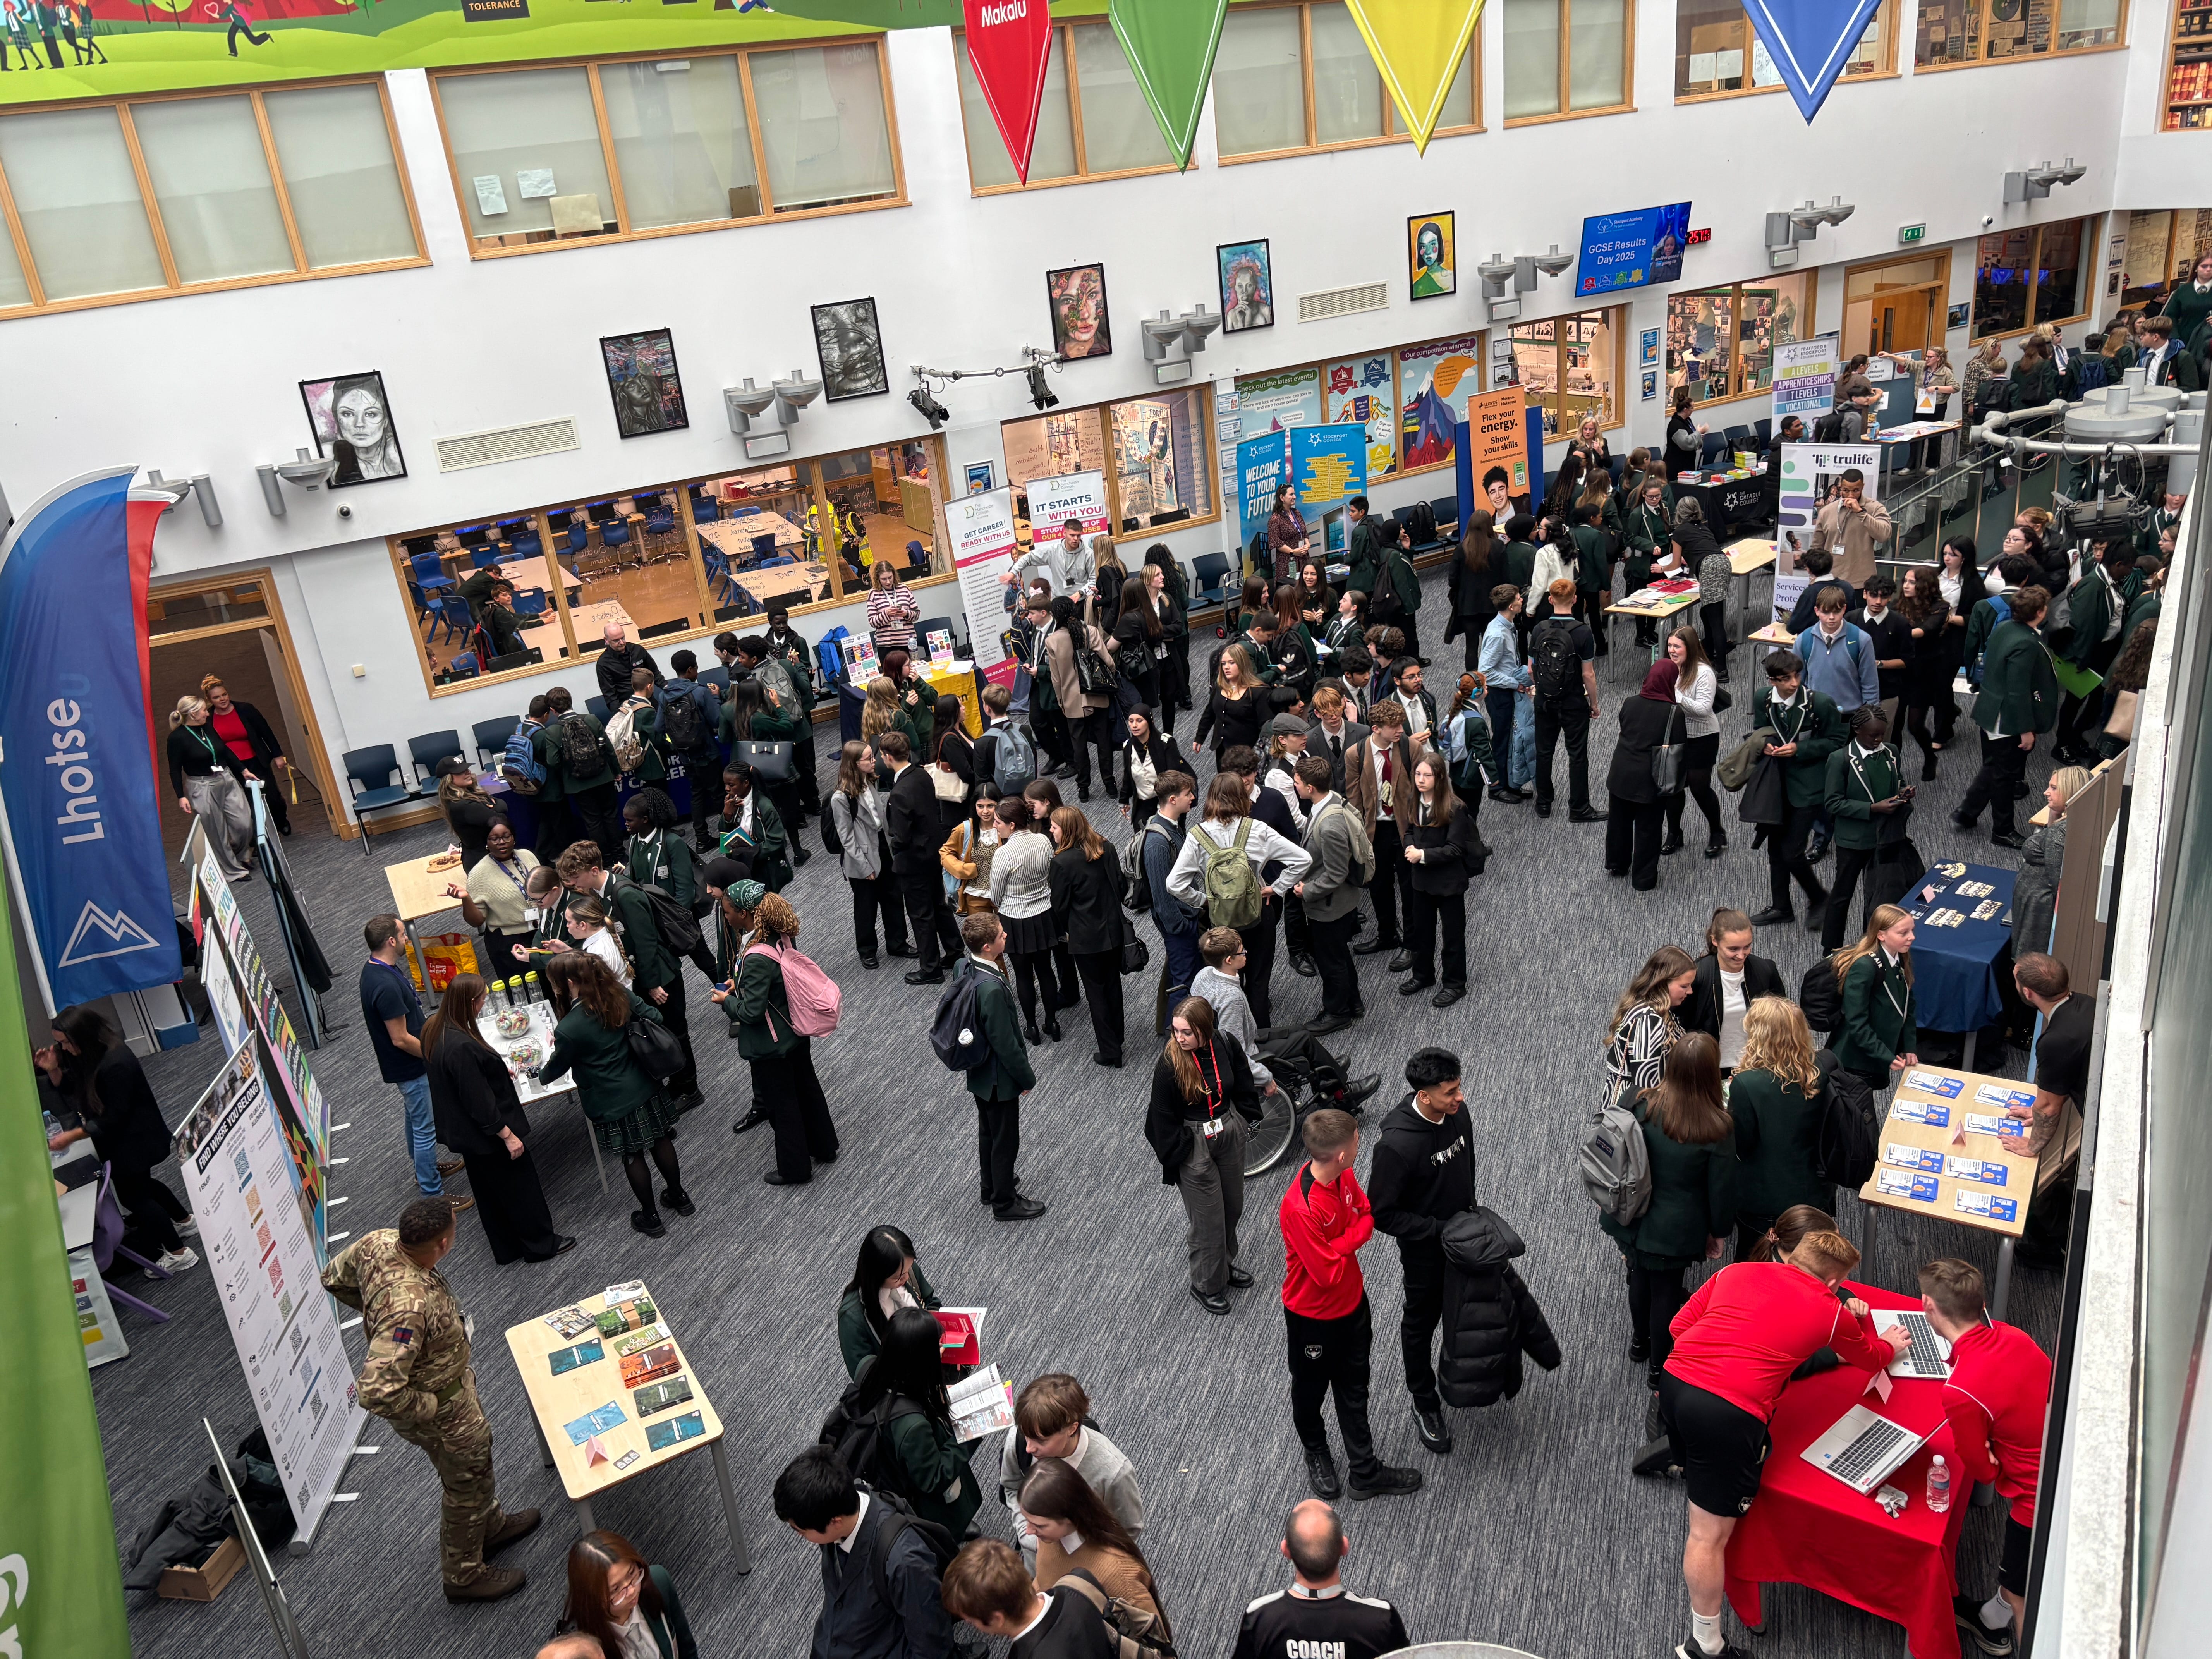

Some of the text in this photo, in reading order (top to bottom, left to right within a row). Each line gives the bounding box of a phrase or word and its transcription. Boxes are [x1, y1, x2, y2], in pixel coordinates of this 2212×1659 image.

[469, 0, 521, 12] TOLERANCE
[981, 0, 1027, 28] Makalu
[1589, 238, 1646, 254] GCSE Results
[1597, 251, 1635, 265] Day 2025
[1417, 346, 1448, 357] competition
[1449, 341, 1470, 350] winners!
[1796, 364, 1819, 375] LEVELS
[1237, 385, 1255, 393] Check
[1294, 372, 1314, 381] events!
[1778, 373, 1832, 390] APPRENTICESHIPS
[1791, 387, 1817, 400] T LEVELS
[1786, 399, 1822, 412] VOCATIONAL
[1482, 409, 1515, 422] Flex your
[1481, 419, 1518, 433] energy.
[1491, 434, 1510, 445] Show
[1484, 441, 1518, 456] your skills
[1833, 453, 1873, 465] trulife
[1246, 459, 1281, 483] WELCOME
[1247, 478, 1276, 499] TO YOUR
[1740, 491, 1761, 501] CHEADLE
[1036, 494, 1092, 512] IT STARTS
[1740, 497, 1759, 506] COLLEGE
[1048, 506, 1101, 521] WITH YOU
[964, 520, 1003, 539] GET CAREER
[1041, 527, 1063, 535] STUDY
[961, 537, 982, 549] READY
[984, 532, 1001, 543] WITH
[1777, 582, 1806, 591] Services
[1776, 593, 1797, 603] Prote
[45, 697, 105, 845] Lhotse
[199, 1147, 211, 1170] FIND
[210, 1125, 228, 1150] WHERE
[227, 1111, 240, 1128] YOU
[238, 1084, 259, 1114] BELONG
[1286, 1639, 1346, 1659] COACH
